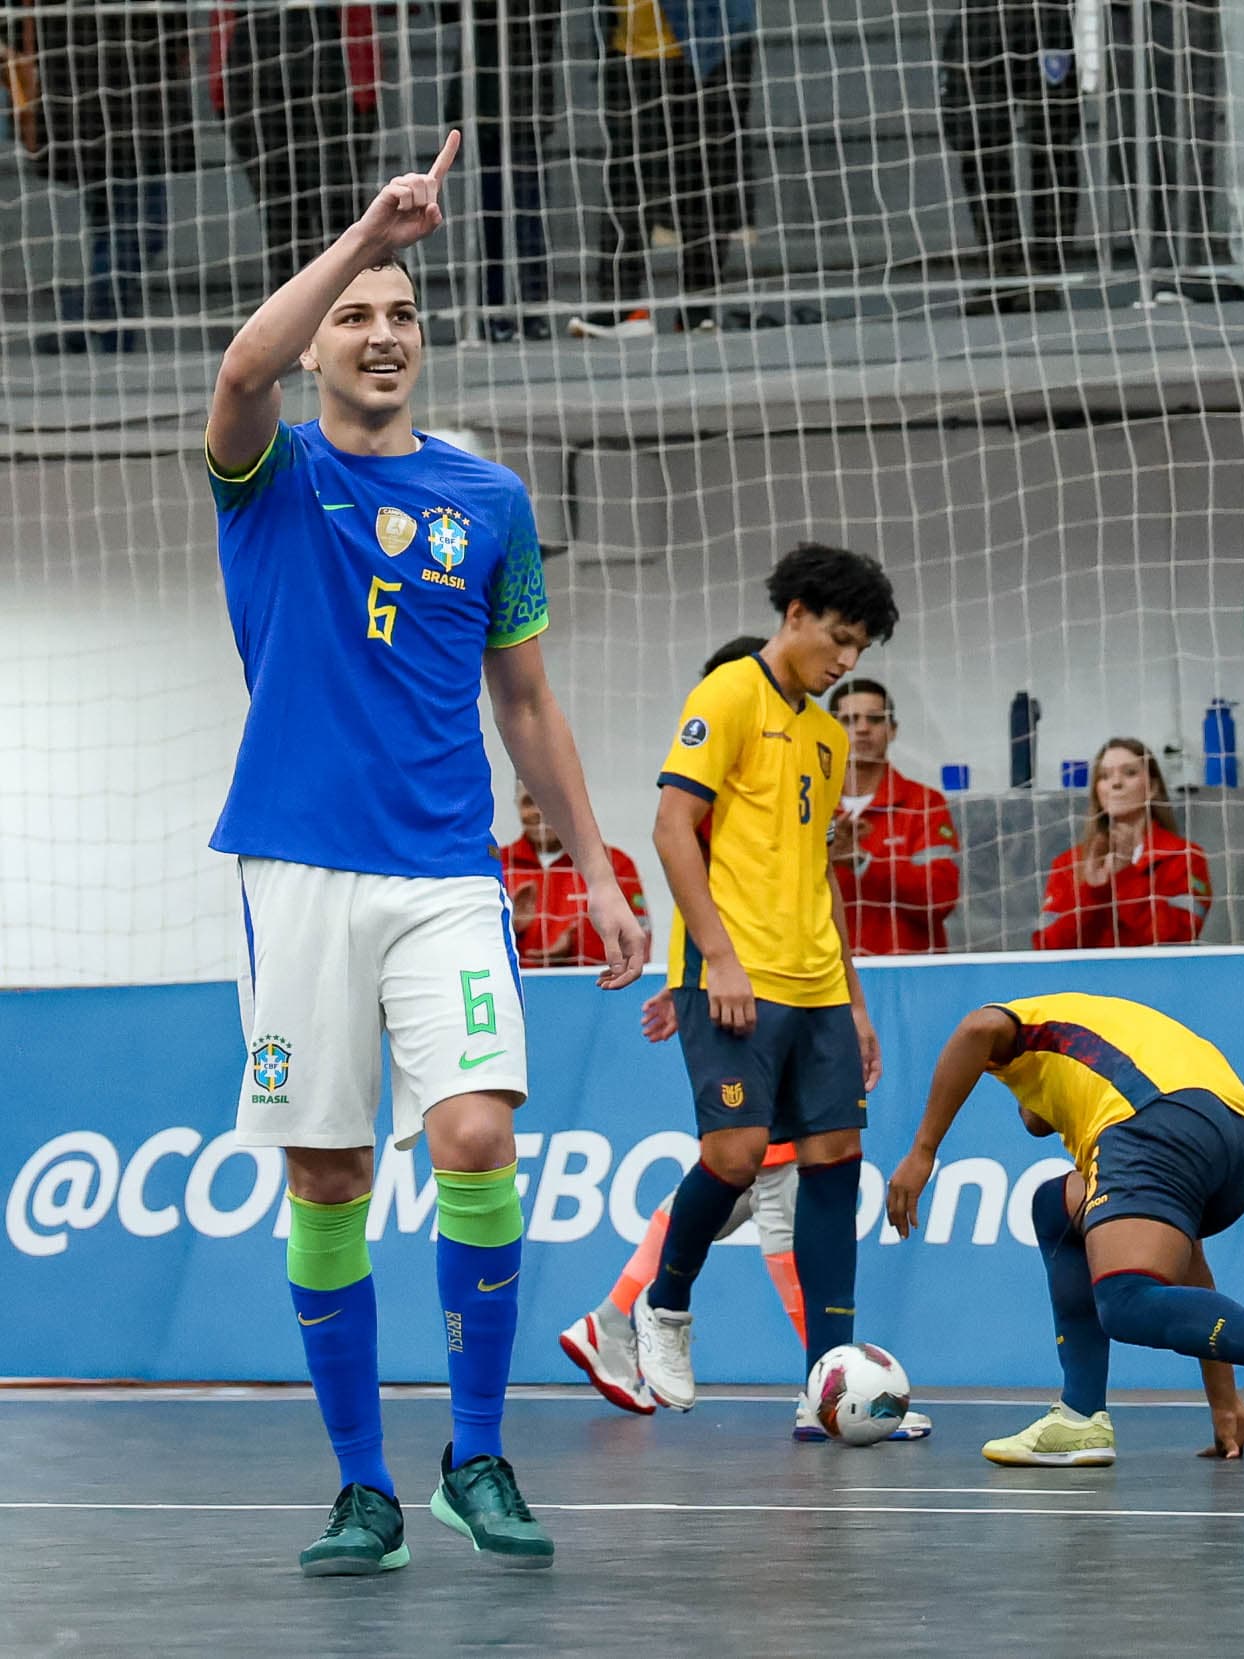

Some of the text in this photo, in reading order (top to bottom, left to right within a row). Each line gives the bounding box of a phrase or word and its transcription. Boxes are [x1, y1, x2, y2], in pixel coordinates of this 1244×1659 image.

[439, 536, 456, 545] CBF
[421, 568, 467, 590] BRASIL
[367, 575, 402, 647] 6
[799, 775, 812, 825] 3
[459, 969, 497, 1036] 6
[263, 1062, 279, 1070] CBF
[251, 1094, 290, 1105] BRASIL
[443, 1310, 464, 1355] BRASIL
